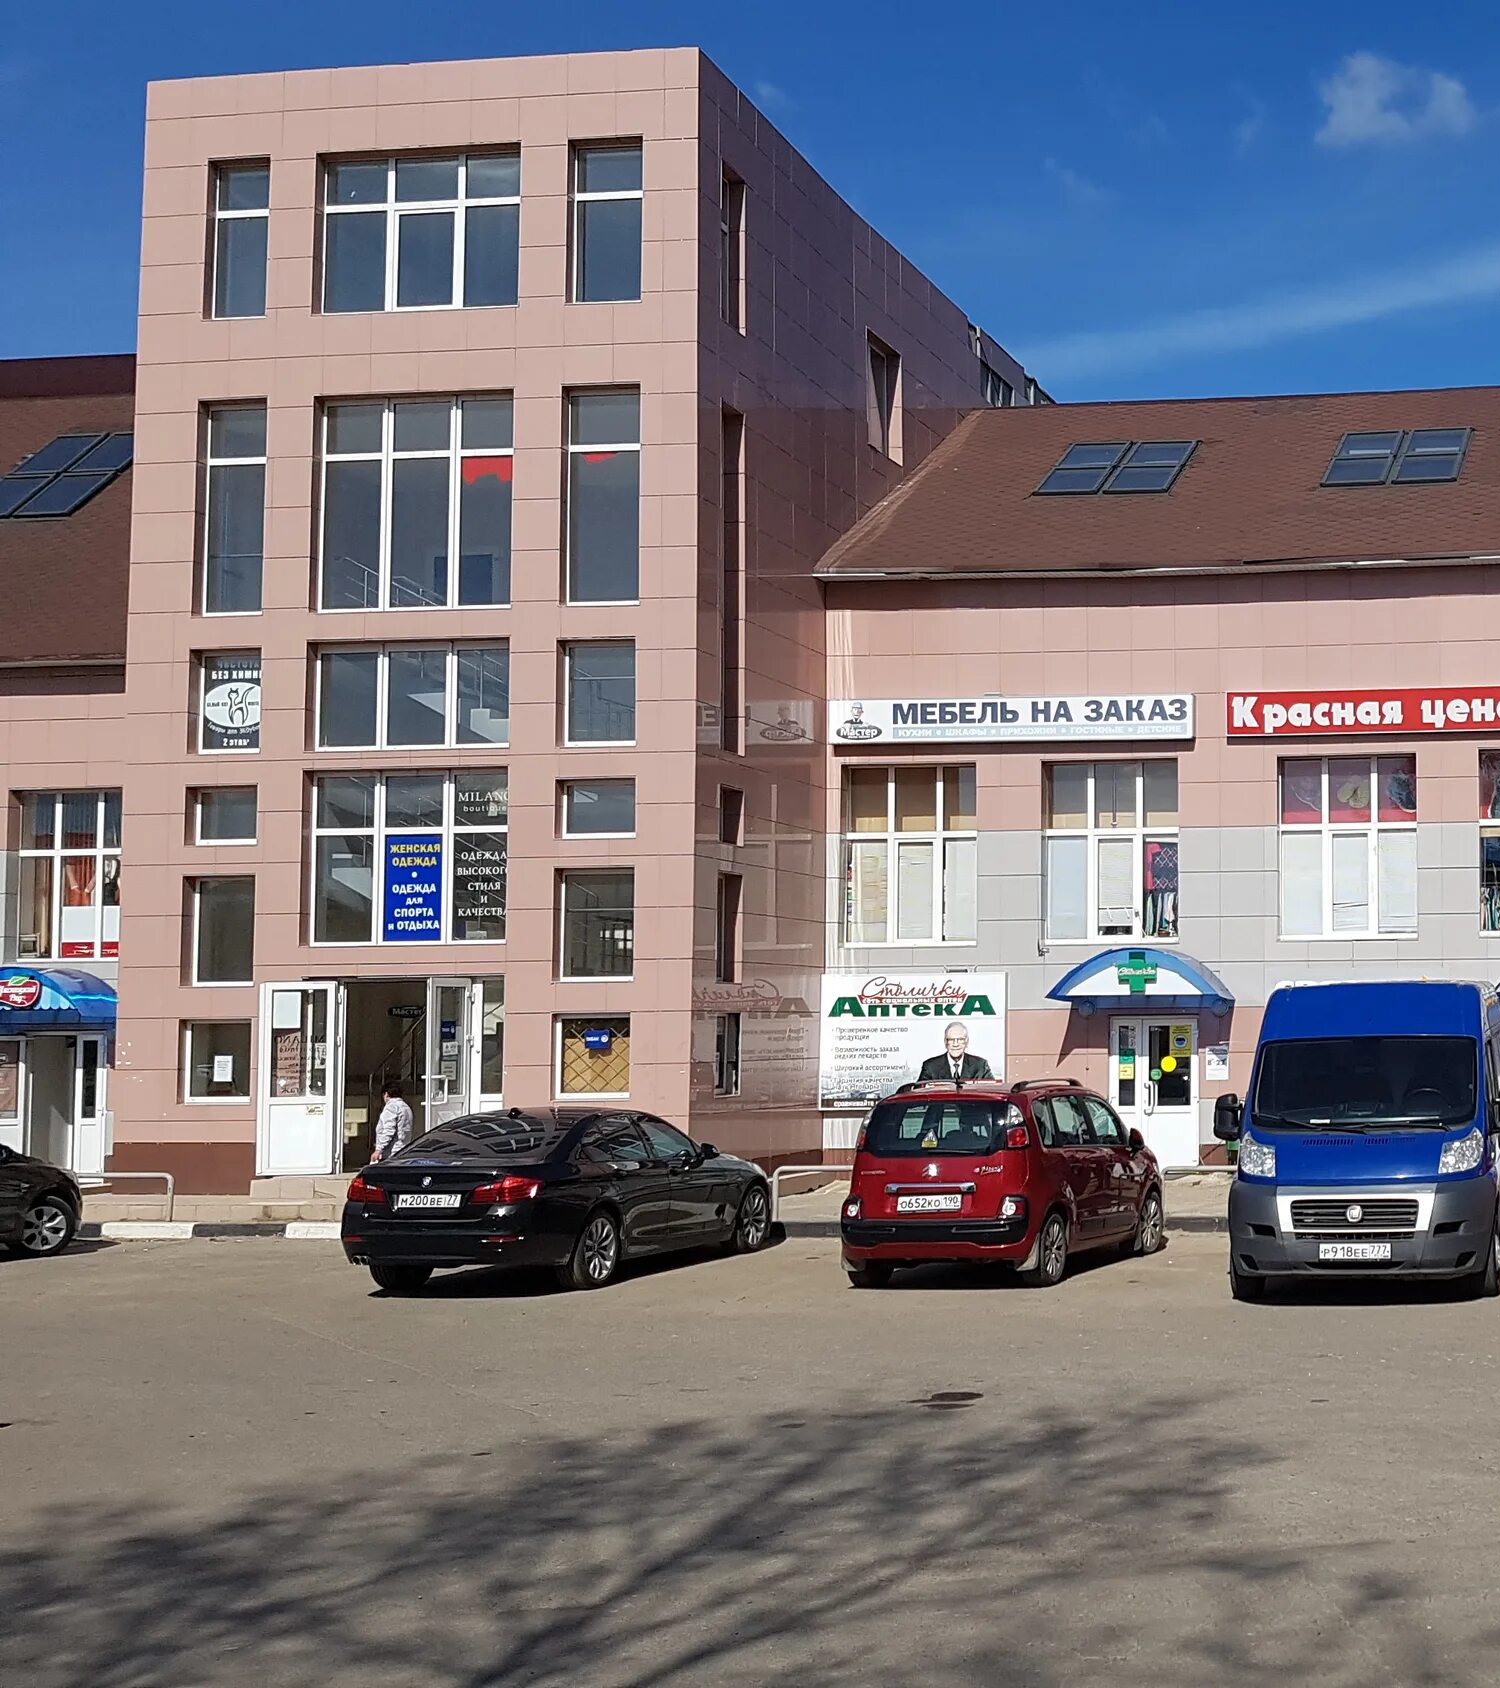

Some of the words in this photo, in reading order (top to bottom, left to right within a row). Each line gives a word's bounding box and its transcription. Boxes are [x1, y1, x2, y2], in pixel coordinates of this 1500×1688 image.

[211, 670, 229, 680] БЕЗ
[892, 701, 1019, 725] МЕБЕЛЬ
[1031, 700, 1074, 723] НА
[1084, 698, 1188, 722] ЗАКАЗ
[1231, 696, 1404, 734] Красная
[840, 726, 878, 739] Мастер
[898, 728, 932, 737] КУХНИ
[944, 727, 987, 737] ШКАФЫ
[1136, 725, 1181, 735] ДЕТСКИЕ
[222, 737, 228, 747] 2
[390, 843, 441, 854] ЖЕНСКАЯ
[391, 856, 437, 868] ОДЕЖДА
[460, 851, 508, 862] ОДЕЖДА
[391, 883, 437, 895] ОДЕЖДА
[467, 882, 501, 892] СТИЛЯ
[480, 895, 488, 904] И
[393, 907, 434, 918] СПОРТА
[457, 907, 507, 918] КАЧЕСТВА
[396, 919, 440, 931] ОТДЫХА
[861, 976, 966, 999] Столички
[827, 994, 997, 1018] АптекА
